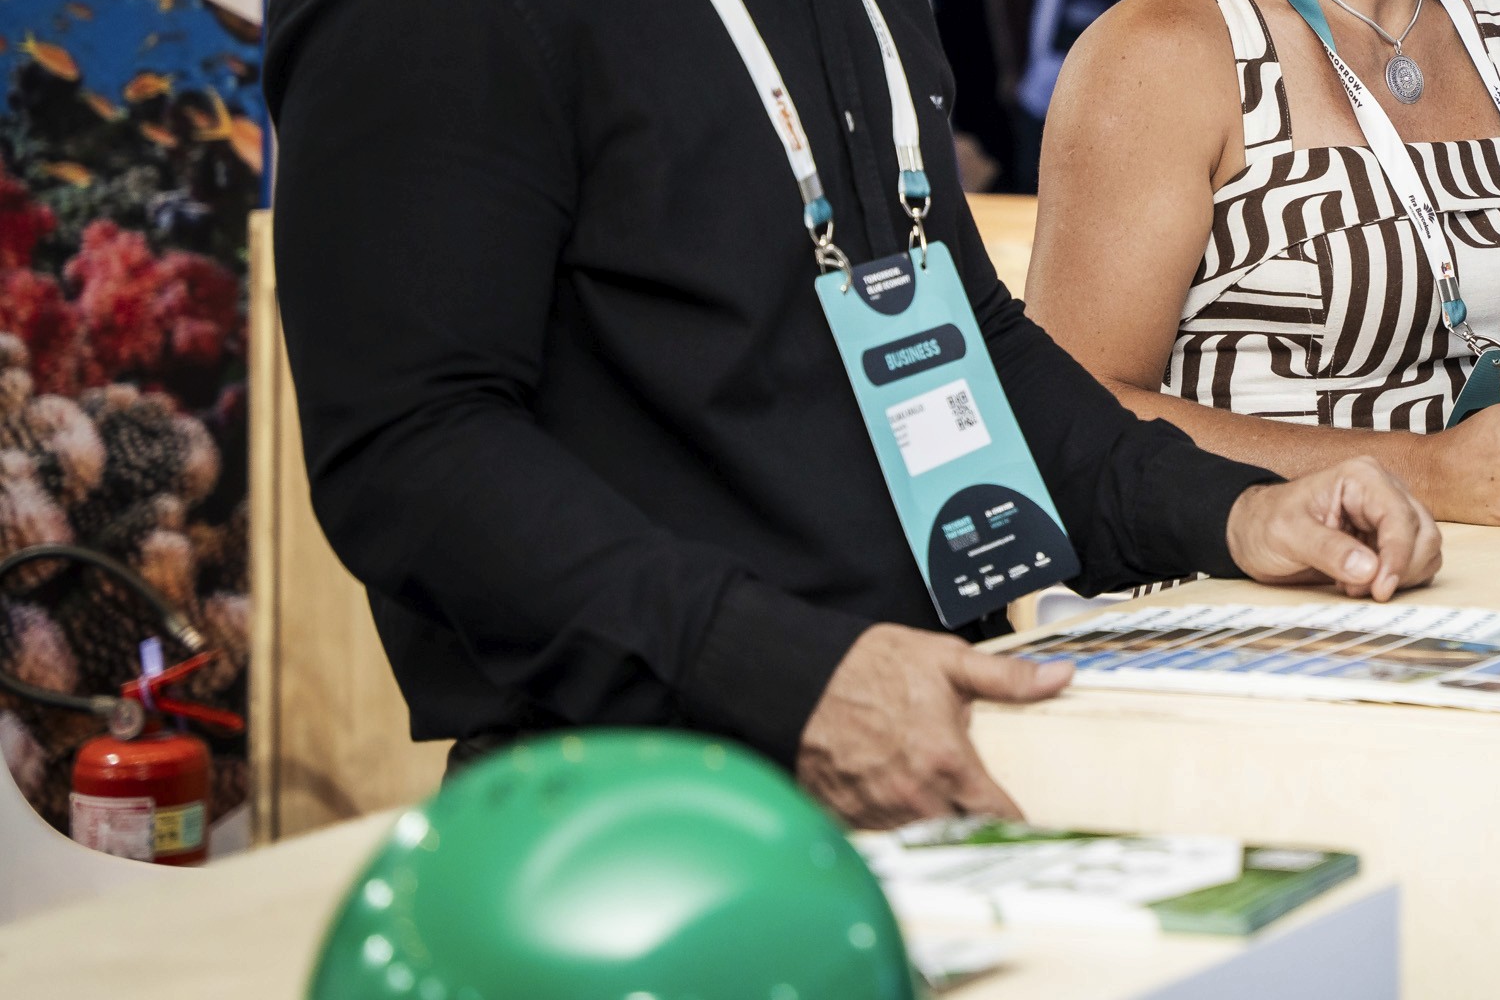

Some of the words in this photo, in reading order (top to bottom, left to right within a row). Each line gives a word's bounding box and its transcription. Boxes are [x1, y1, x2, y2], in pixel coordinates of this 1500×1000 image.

[1323, 43, 1362, 95] OMORROW.
[1408, 194, 1419, 208] Fira
[1415, 206, 1432, 240] Barcelona
[884, 338, 942, 371] BUSINESS
